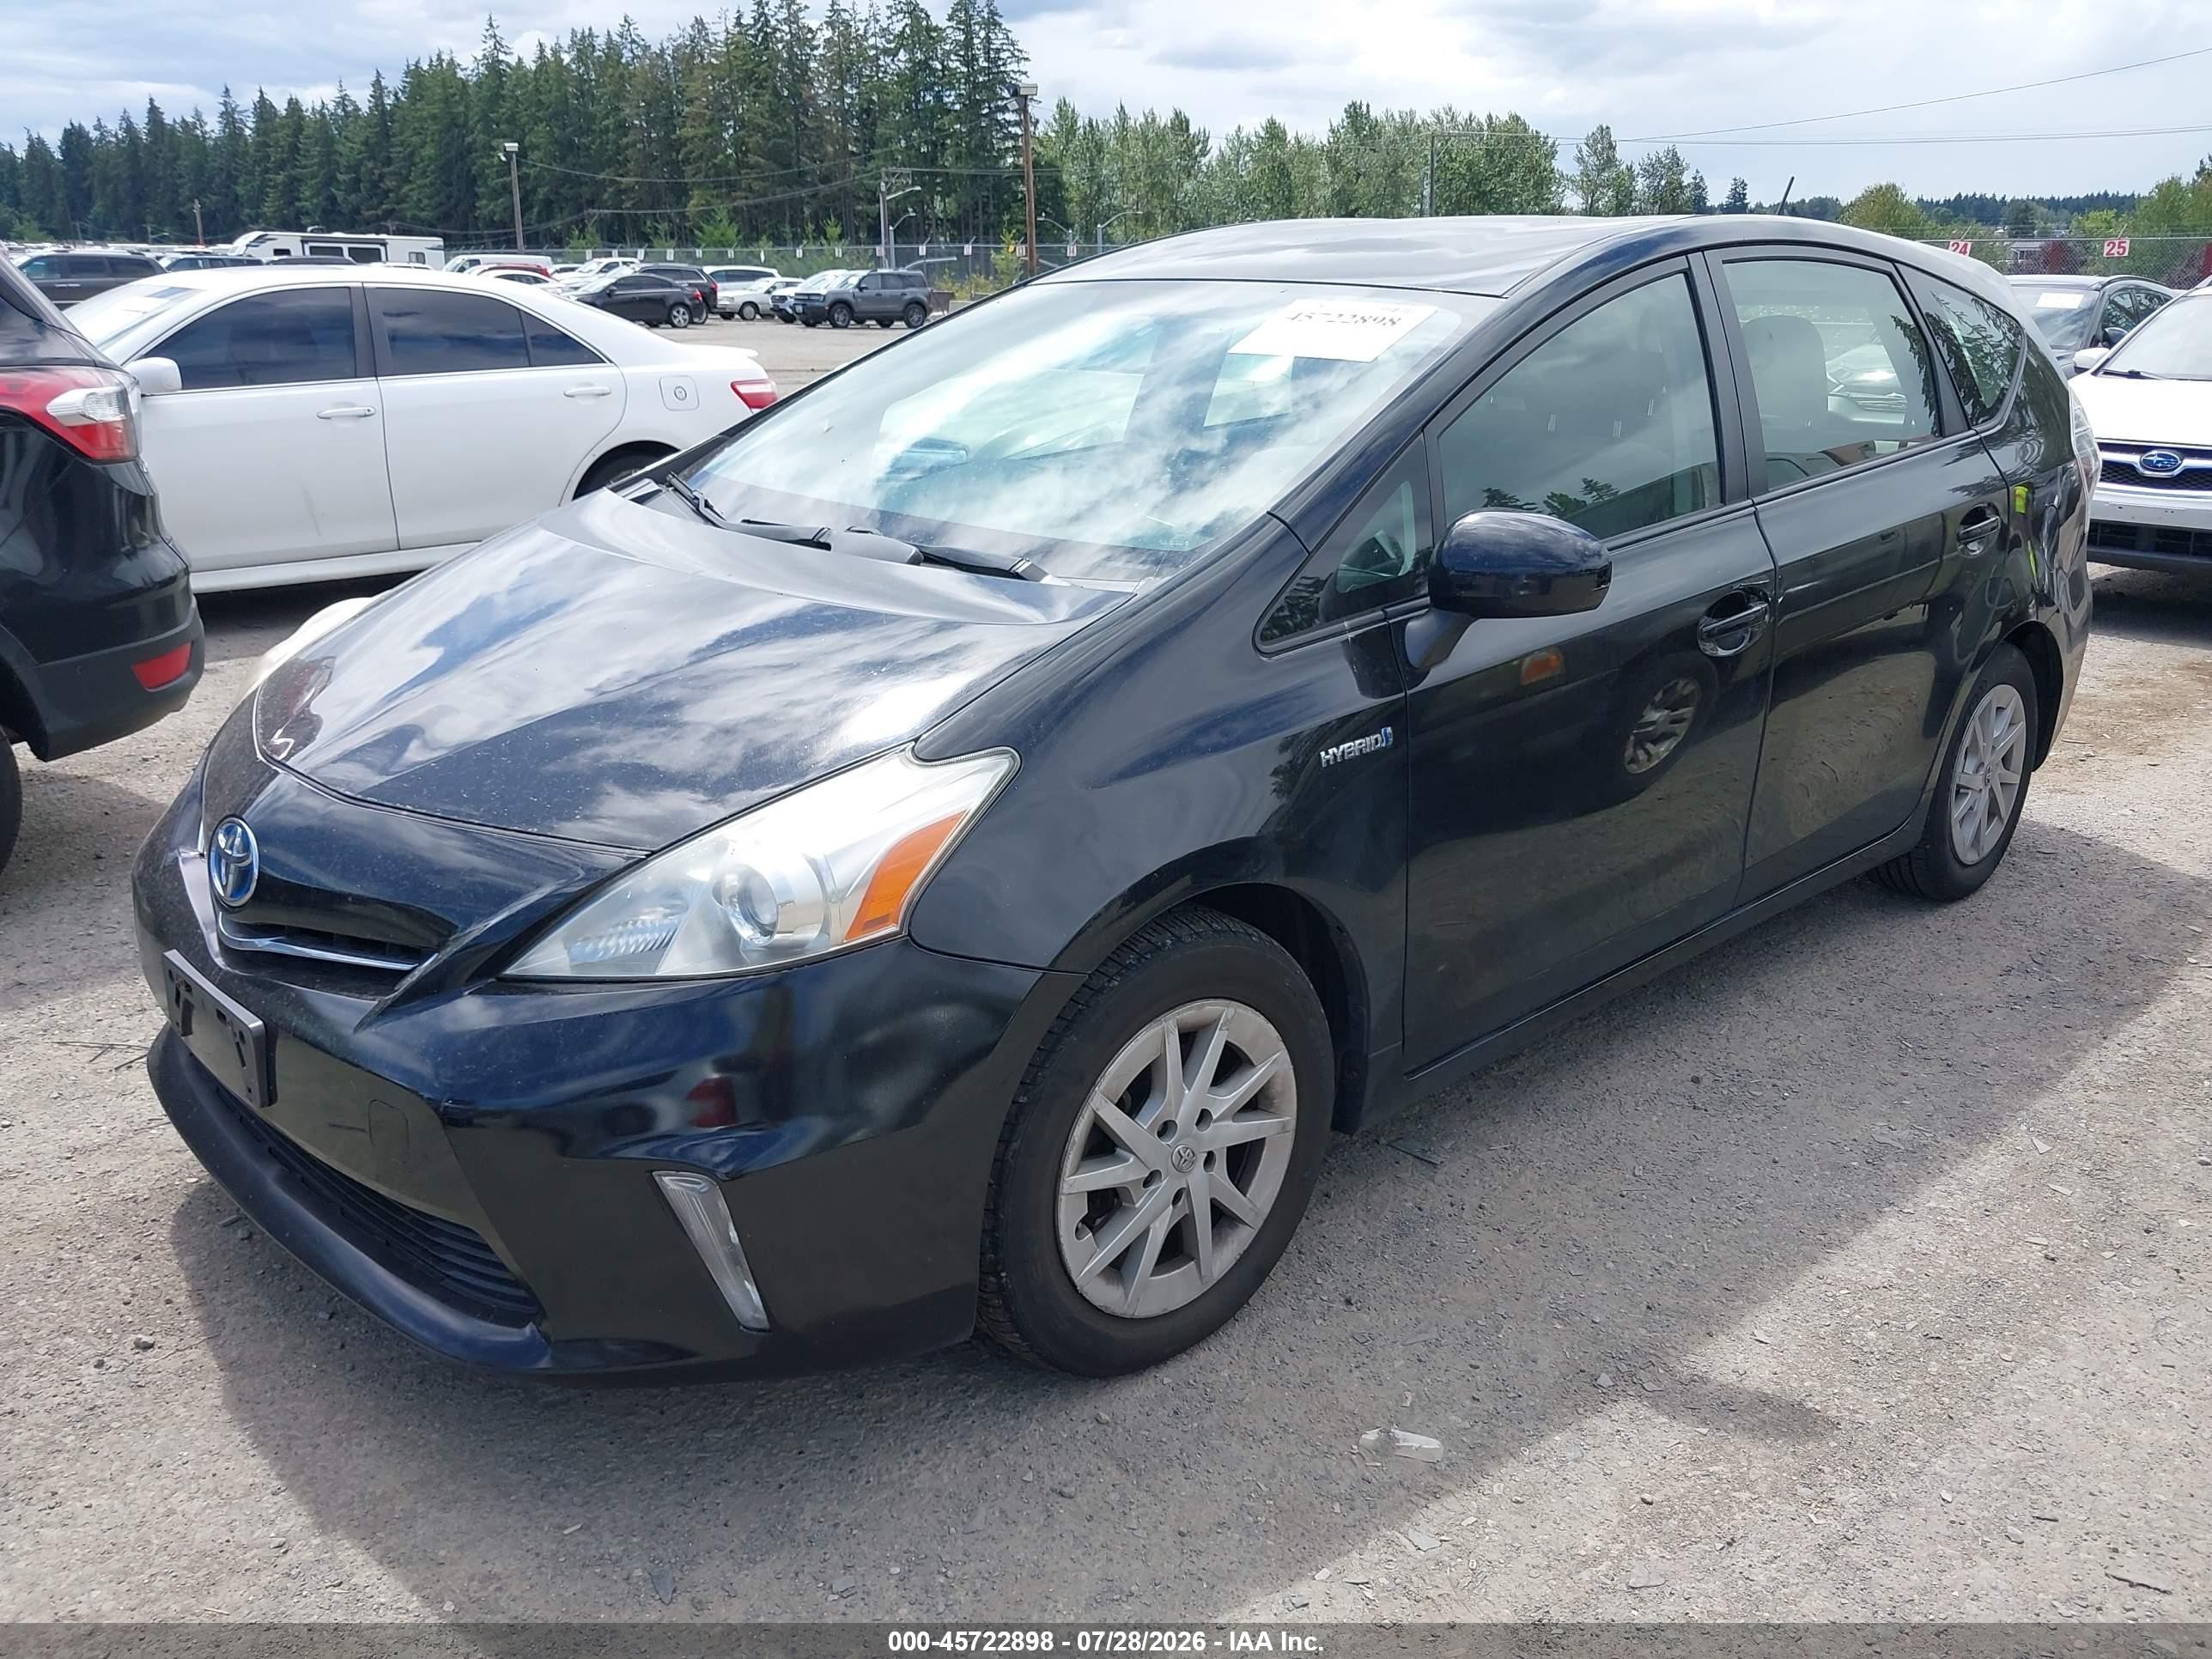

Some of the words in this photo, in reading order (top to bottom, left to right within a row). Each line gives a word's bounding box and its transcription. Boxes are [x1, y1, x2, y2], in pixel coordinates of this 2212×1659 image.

[1951, 241, 1968, 256] 24
[2106, 240, 2127, 256] 25
[1320, 733, 1382, 768] HYBRID
